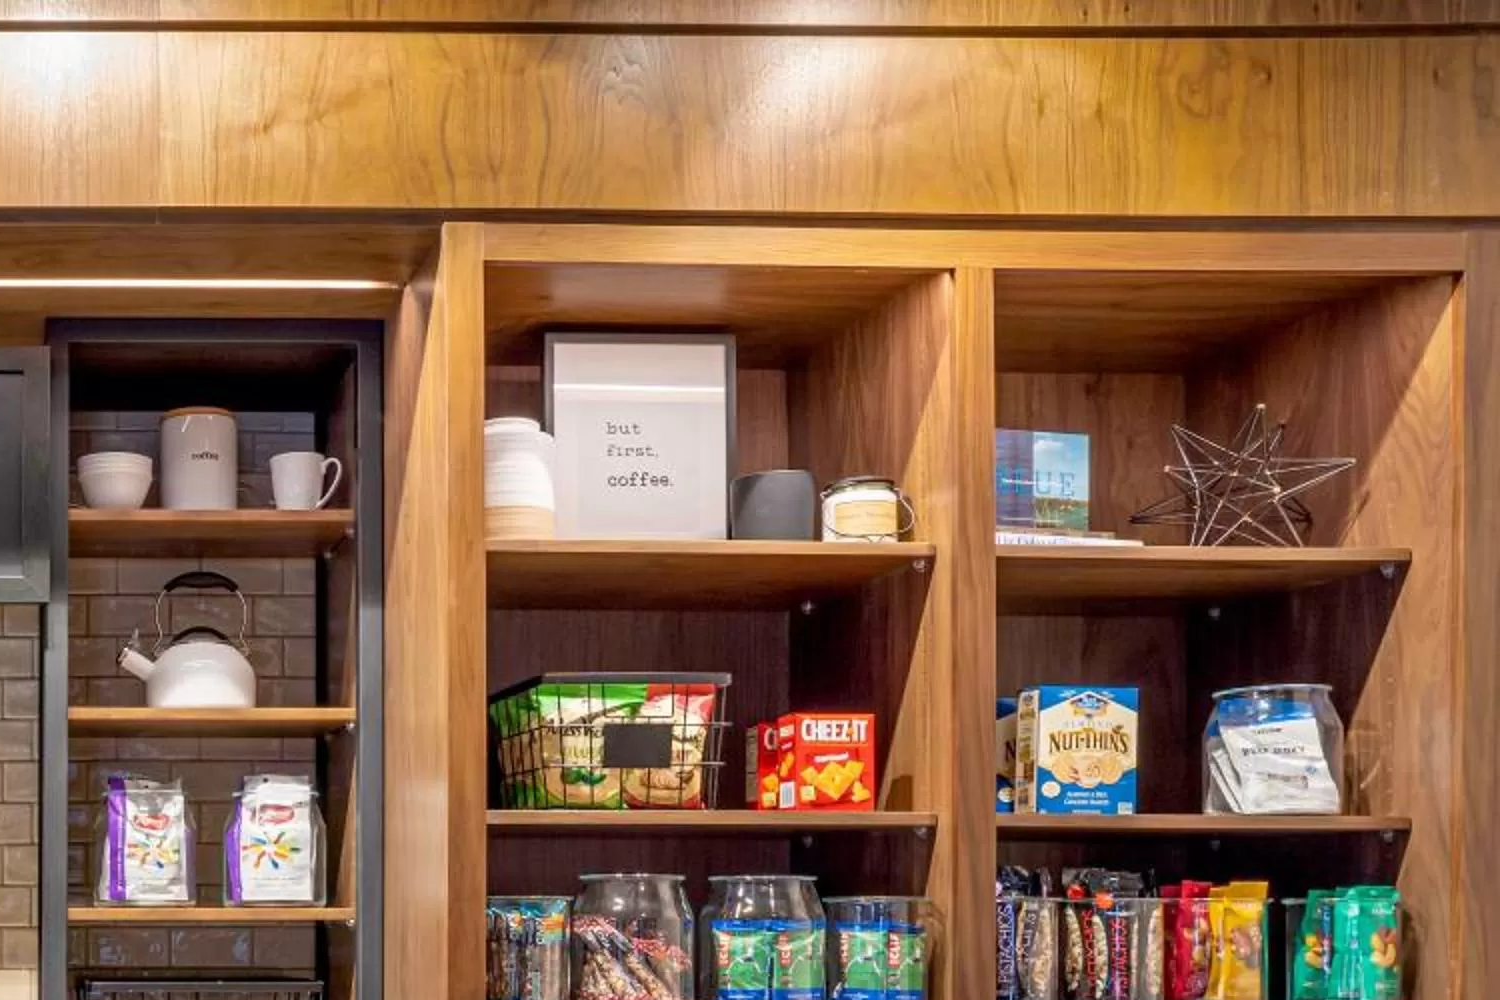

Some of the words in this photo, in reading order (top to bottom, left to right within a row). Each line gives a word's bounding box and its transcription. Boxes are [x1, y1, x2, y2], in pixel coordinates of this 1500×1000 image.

[606, 421, 642, 435] but
[606, 444, 660, 459] first,
[606, 472, 674, 488] coffee.
[1049, 730, 1129, 754] NUT-THINS
